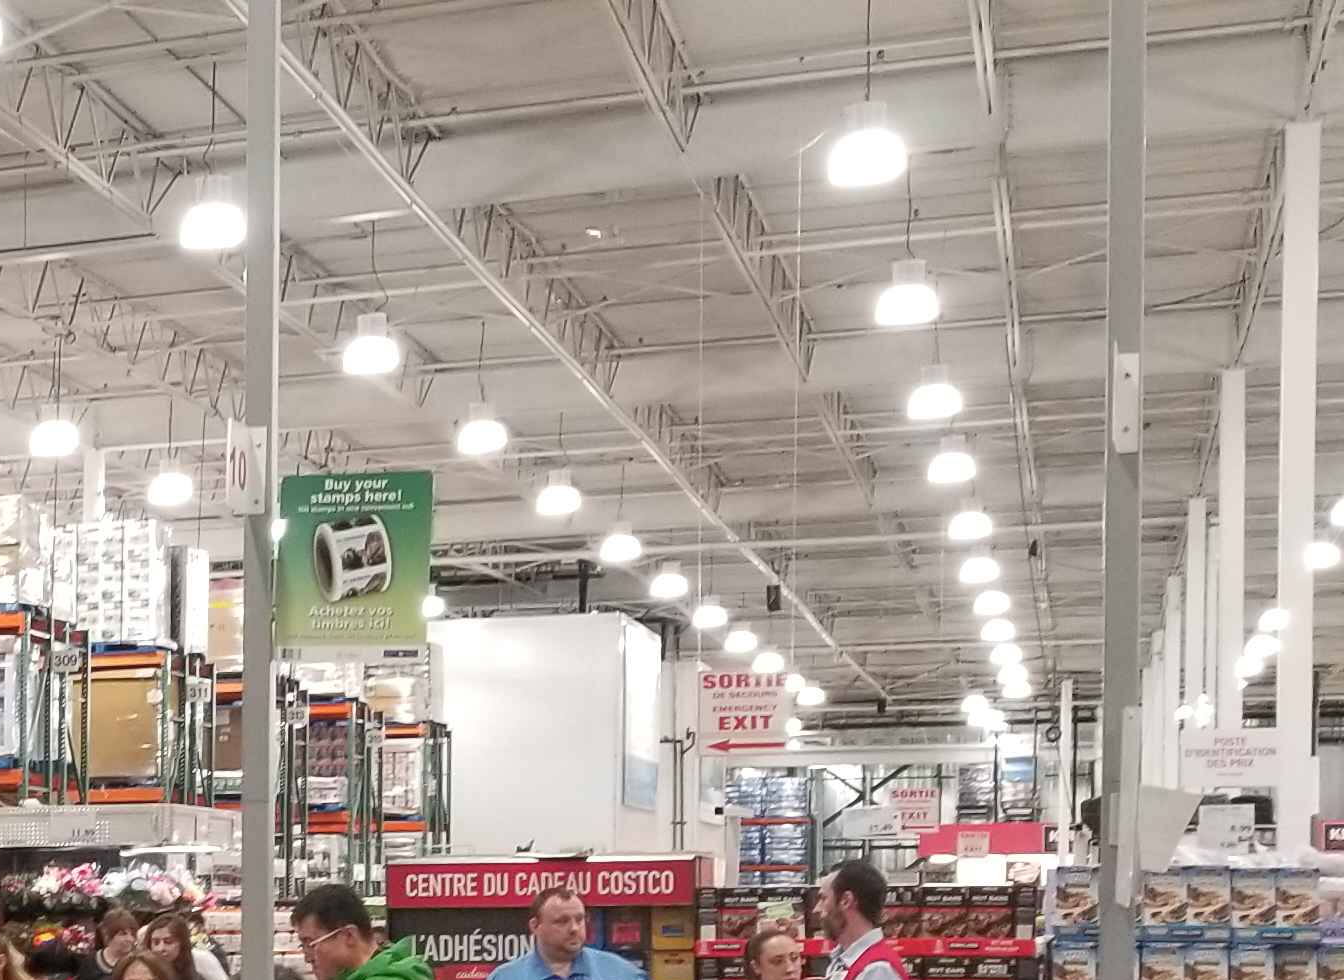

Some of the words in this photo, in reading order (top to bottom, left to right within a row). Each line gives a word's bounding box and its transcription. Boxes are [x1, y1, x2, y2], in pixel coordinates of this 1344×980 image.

[229, 447, 246, 490] 10
[324, 479, 351, 493] Buy
[355, 478, 389, 493] your
[310, 491, 362, 505] stamps
[364, 489, 403, 502] here!
[53, 654, 77, 667] 309
[703, 672, 787, 689] SORTIE
[190, 686, 208, 699] 311
[718, 714, 773, 730] EXIT
[891, 789, 936, 799] SORTIE
[406, 873, 478, 896] CENTRE
[483, 872, 508, 895] DU
[515, 871, 591, 895] CADEAU
[598, 870, 674, 894] COSTCO
[412, 928, 535, 961] L'ADHÉSION
